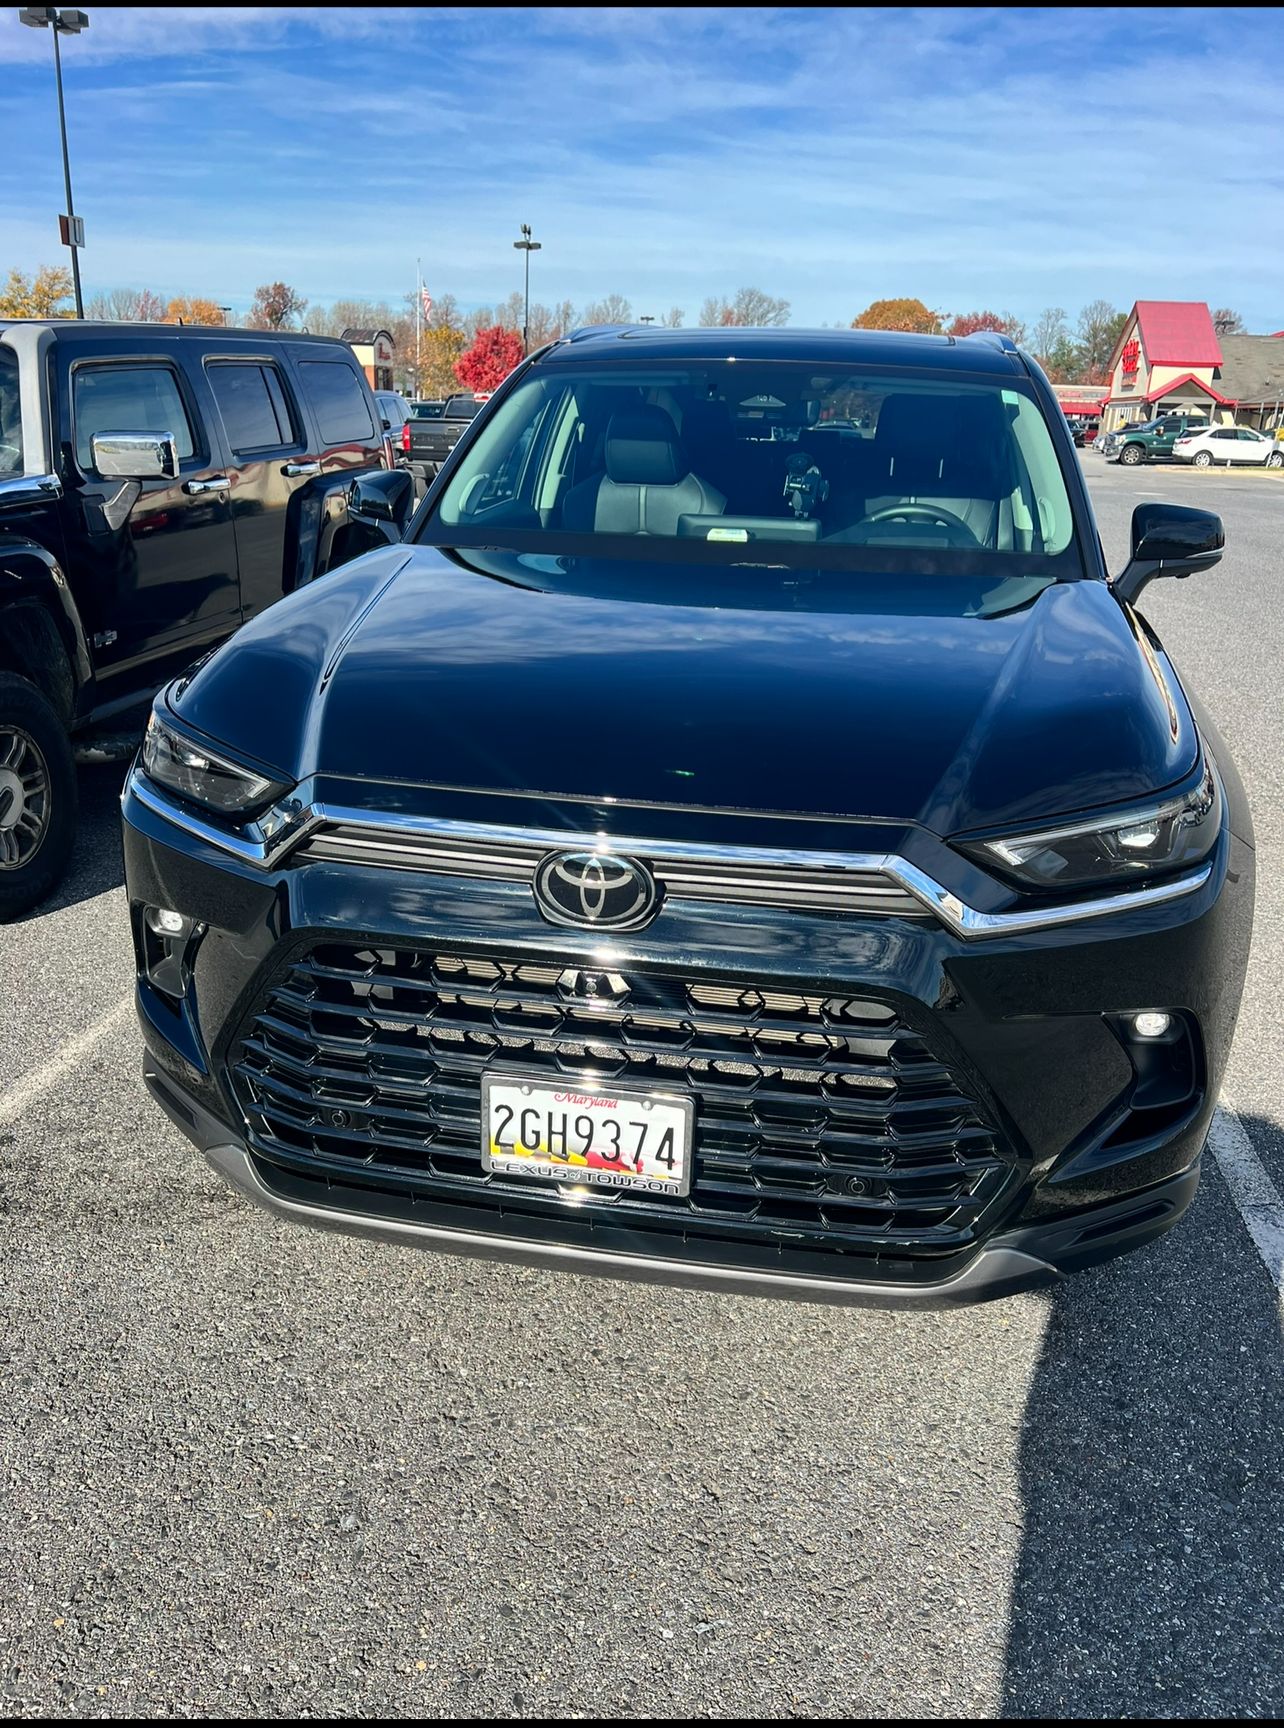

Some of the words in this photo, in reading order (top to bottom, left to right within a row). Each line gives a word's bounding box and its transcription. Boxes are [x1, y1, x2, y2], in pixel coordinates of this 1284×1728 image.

[554, 1092, 619, 1110] Maryland
[494, 1104, 676, 1171] 2GH9374
[491, 1159, 567, 1179] LEXUS
[581, 1172, 680, 1195] TOWSON
